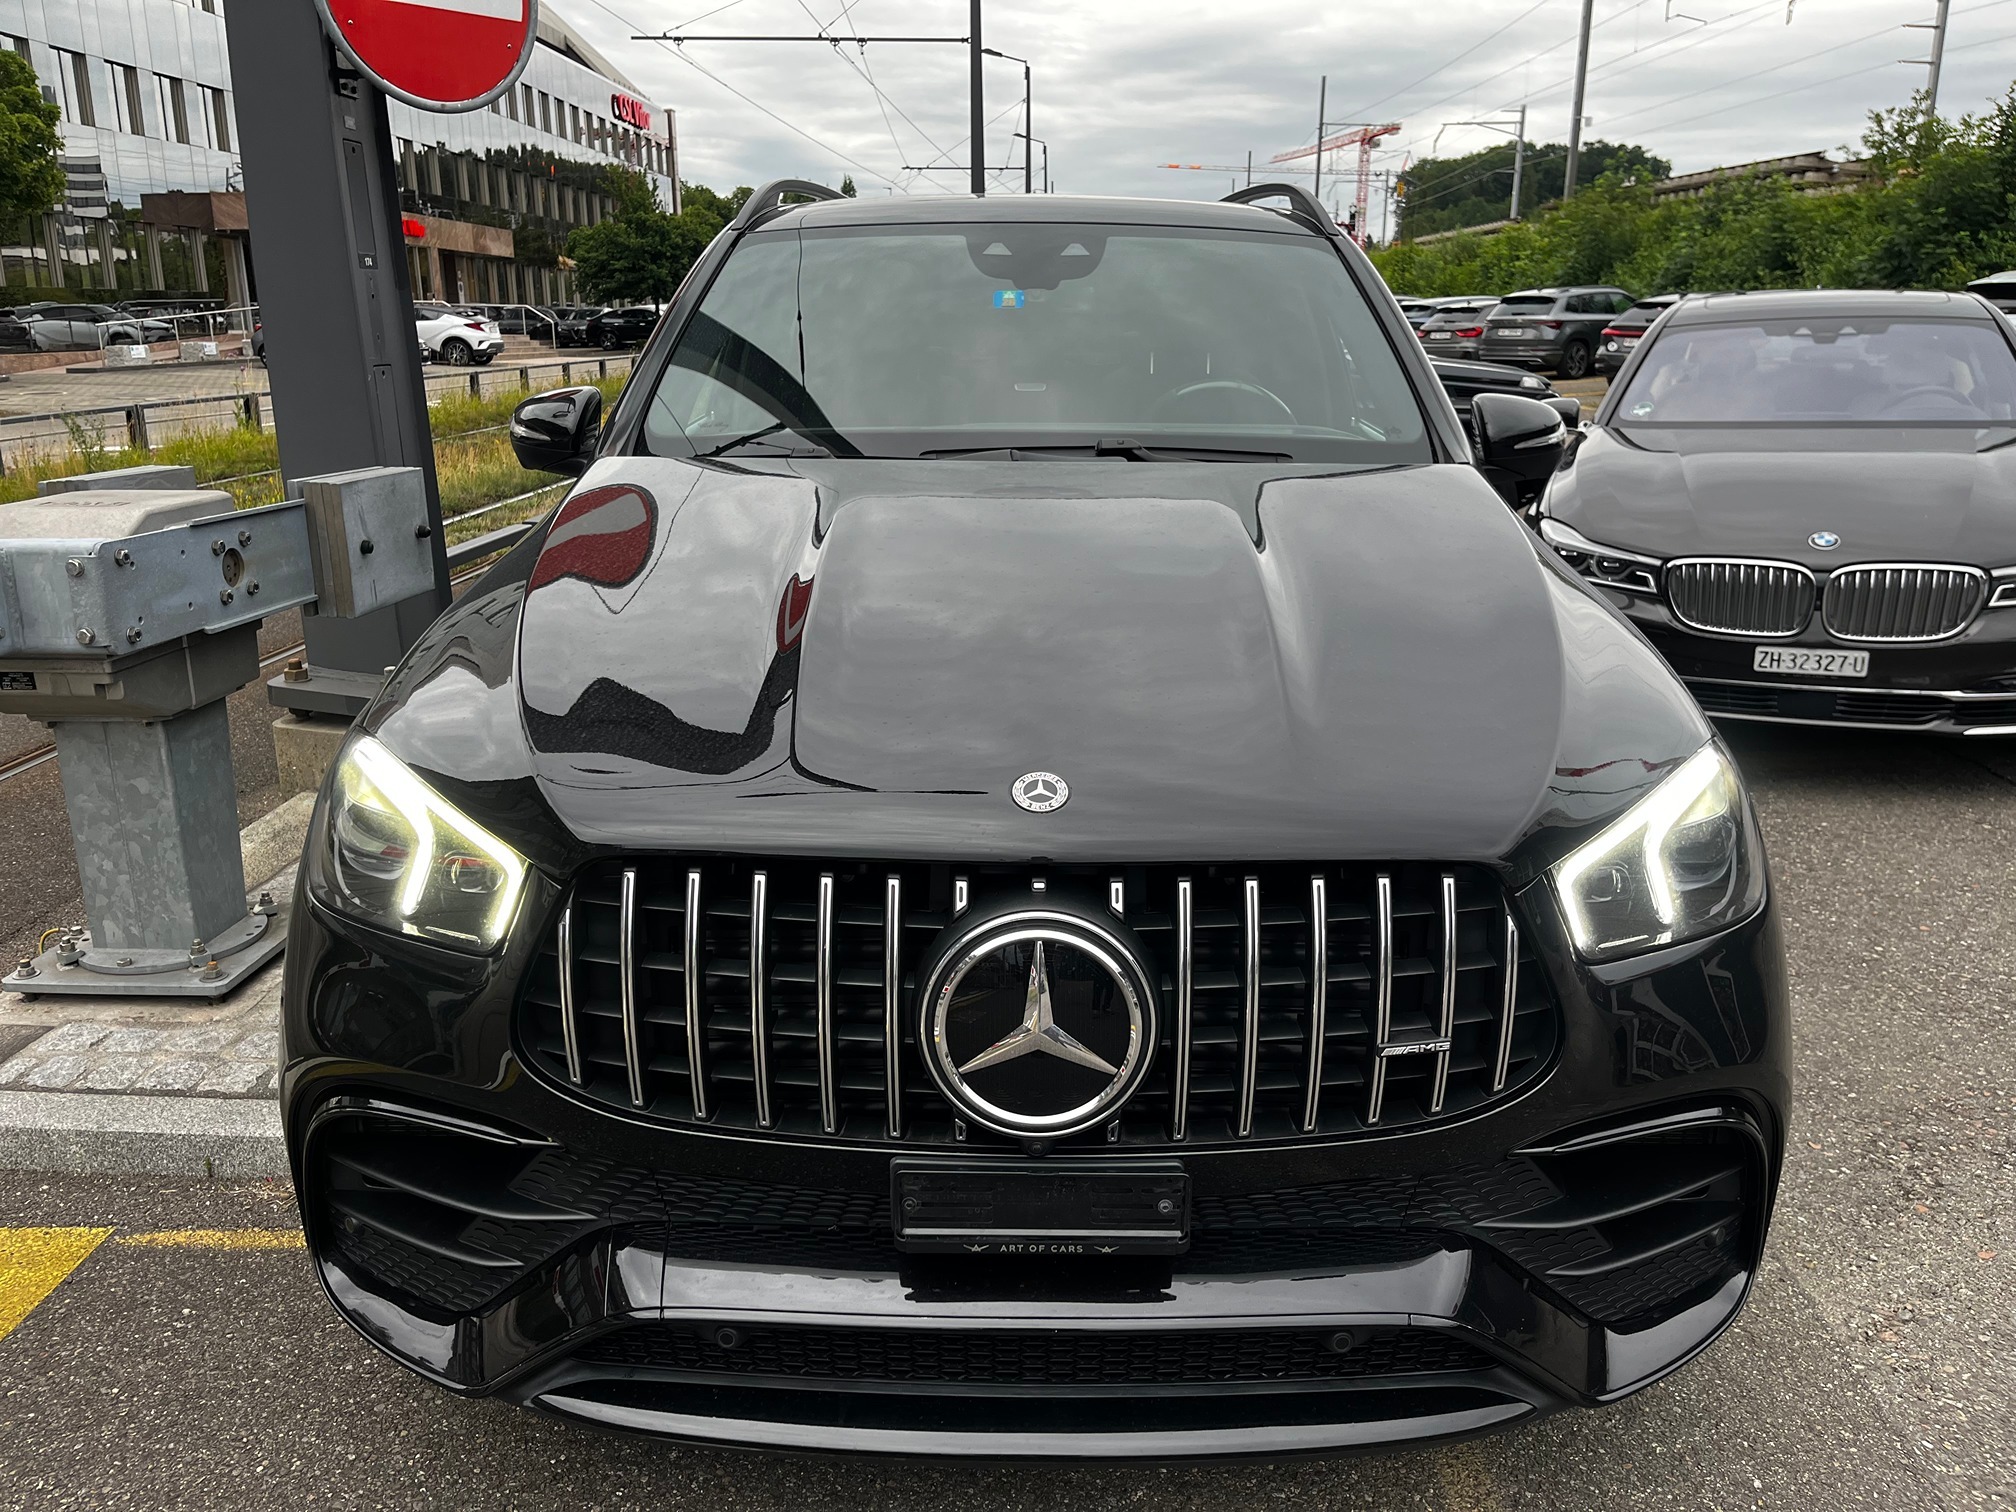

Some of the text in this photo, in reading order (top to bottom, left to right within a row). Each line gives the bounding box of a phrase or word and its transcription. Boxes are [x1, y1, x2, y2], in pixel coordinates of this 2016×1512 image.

[364, 257, 373, 266] 174
[1402, 1041, 1451, 1055] AMG
[999, 1244, 1083, 1253] ART OF CARS
